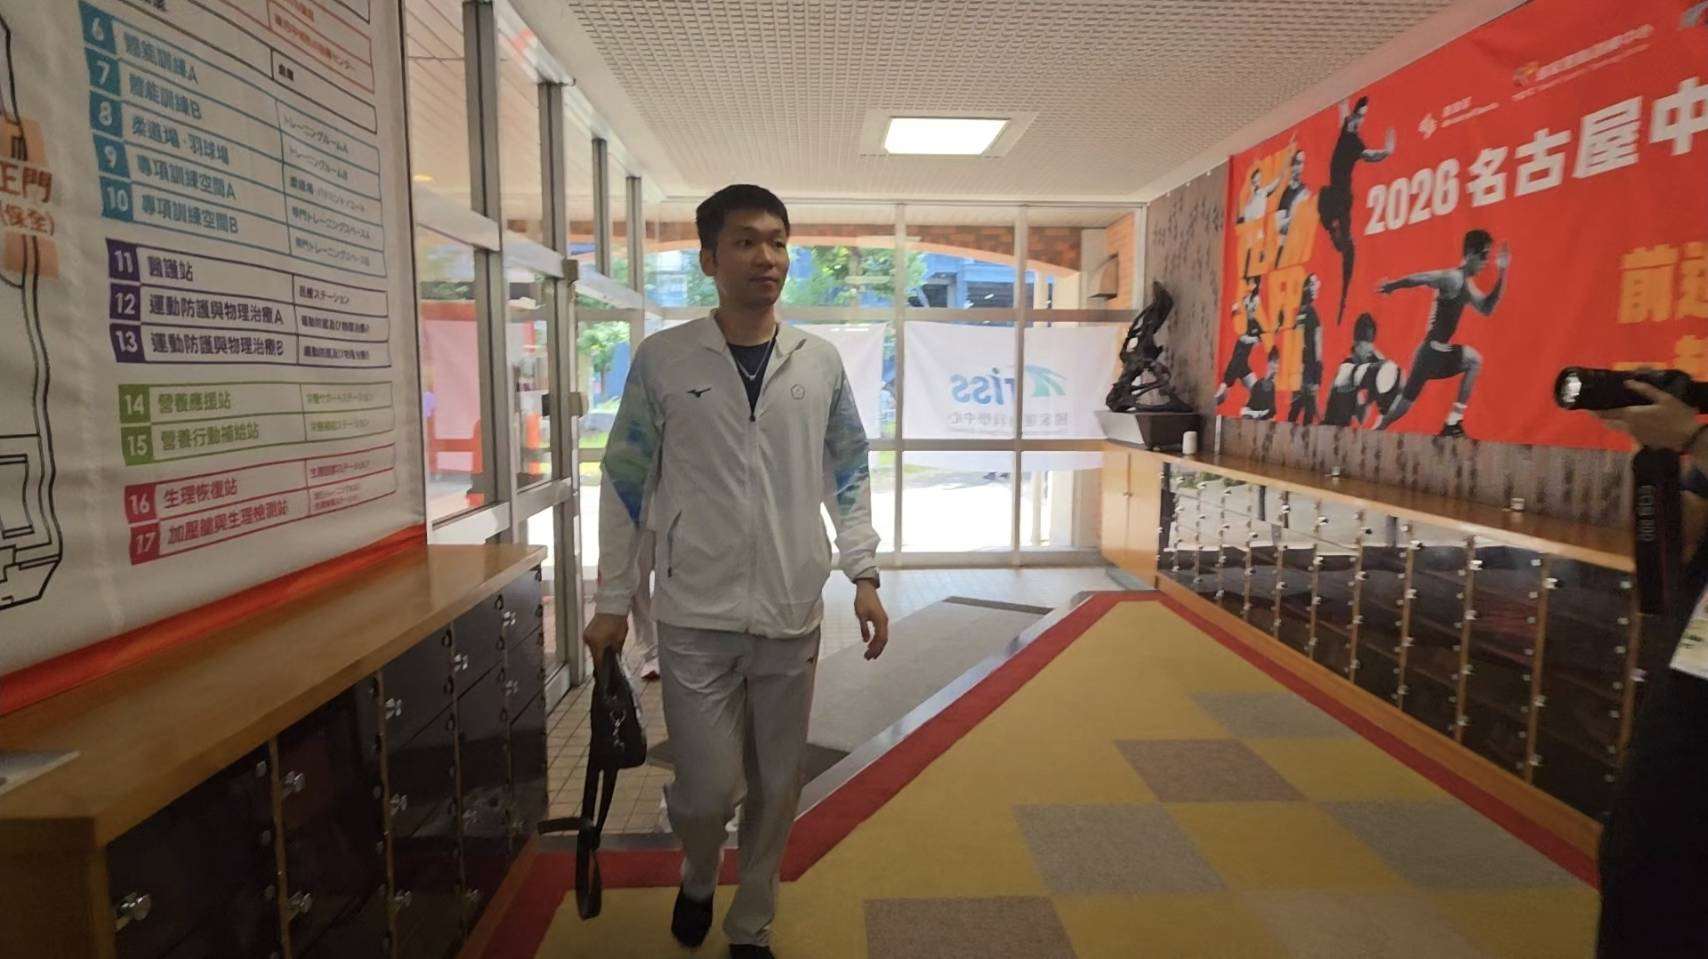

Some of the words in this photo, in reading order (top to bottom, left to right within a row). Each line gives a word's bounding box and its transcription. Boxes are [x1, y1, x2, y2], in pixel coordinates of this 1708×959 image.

[92, 18, 105, 41] 6
[96, 61, 110, 85] 7
[98, 101, 113, 126] 8
[104, 145, 117, 169] 9
[1363, 158, 1461, 236] 2026
[1466, 76, 1708, 208] 名古屋中
[137, 154, 237, 201] 專項訓練空間A
[106, 186, 128, 212] 10
[142, 194, 239, 234] 專項訓練空間B
[114, 250, 133, 273] 11
[147, 255, 193, 282] 醫護站
[115, 292, 136, 315] 12
[149, 293, 284, 325] 運動防護與物理治療A
[115, 330, 138, 353] 13
[151, 332, 284, 356] 運動防護與物理治療B
[124, 395, 144, 415] 14
[158, 391, 231, 414] 營養應援站
[128, 434, 148, 456] 15
[161, 422, 259, 451] 營養行動補給站
[130, 494, 150, 515] 16
[163, 478, 239, 509] 生理恢復站
[135, 532, 156, 554] 17
